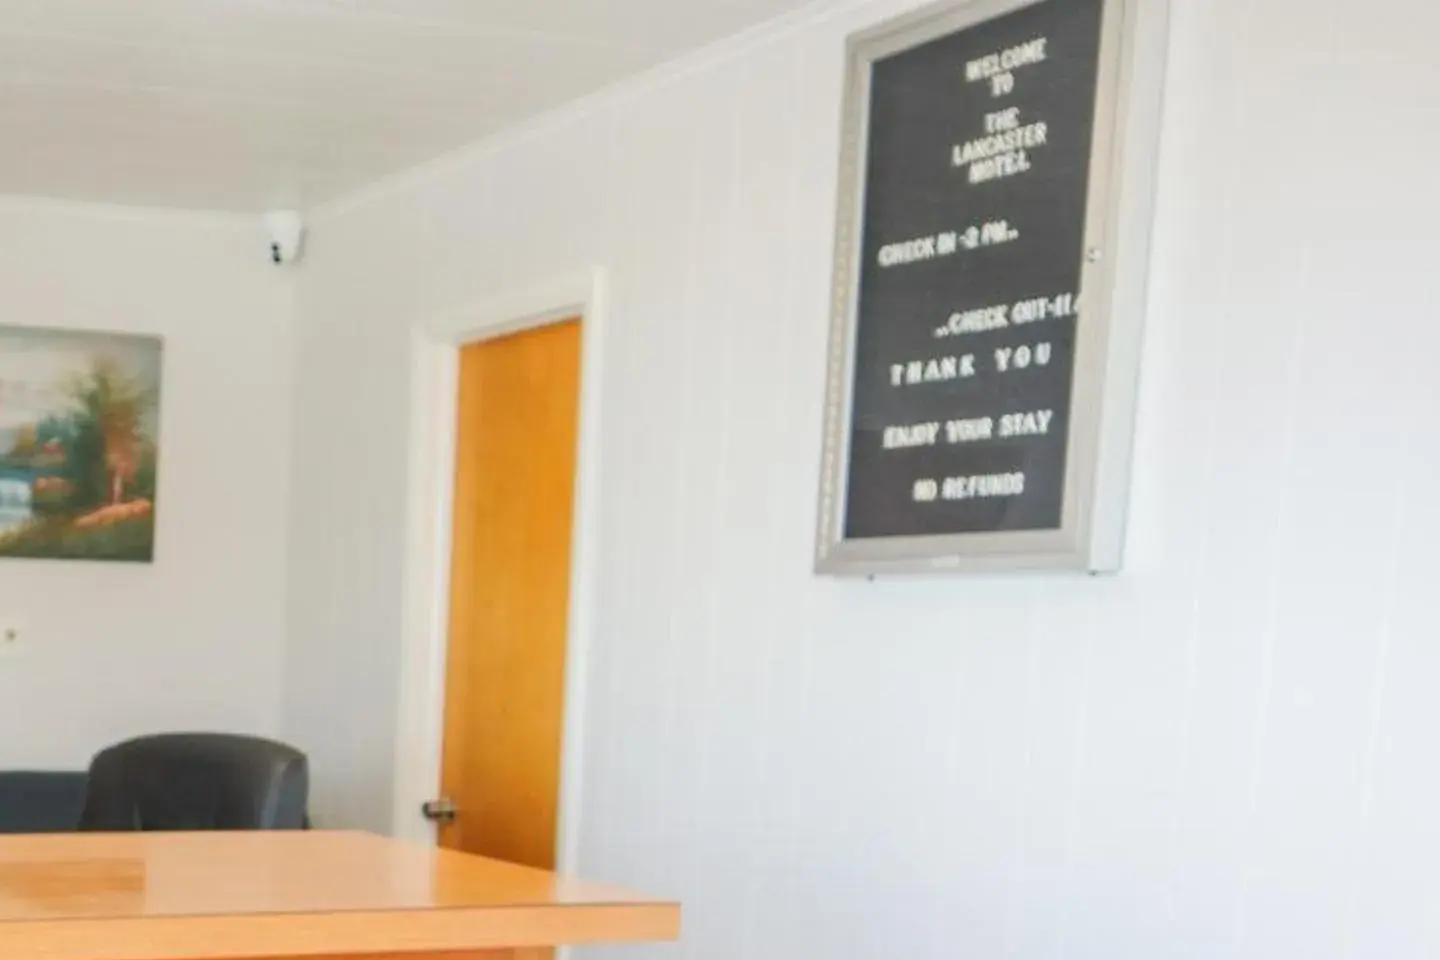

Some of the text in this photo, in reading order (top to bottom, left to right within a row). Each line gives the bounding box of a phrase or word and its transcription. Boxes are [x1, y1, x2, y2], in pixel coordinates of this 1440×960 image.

[965, 37, 1048, 82] WELCOME
[991, 71, 1015, 98] TO
[984, 106, 1020, 134] THE
[951, 121, 1047, 167] LANCASTER
[877, 235, 935, 267] CHECK
[937, 230, 957, 255] IN
[890, 341, 1051, 387] THANK YOU
[882, 409, 1053, 449] ENJOY YOUR STAY
[913, 471, 1025, 502] NO REFUNDS
